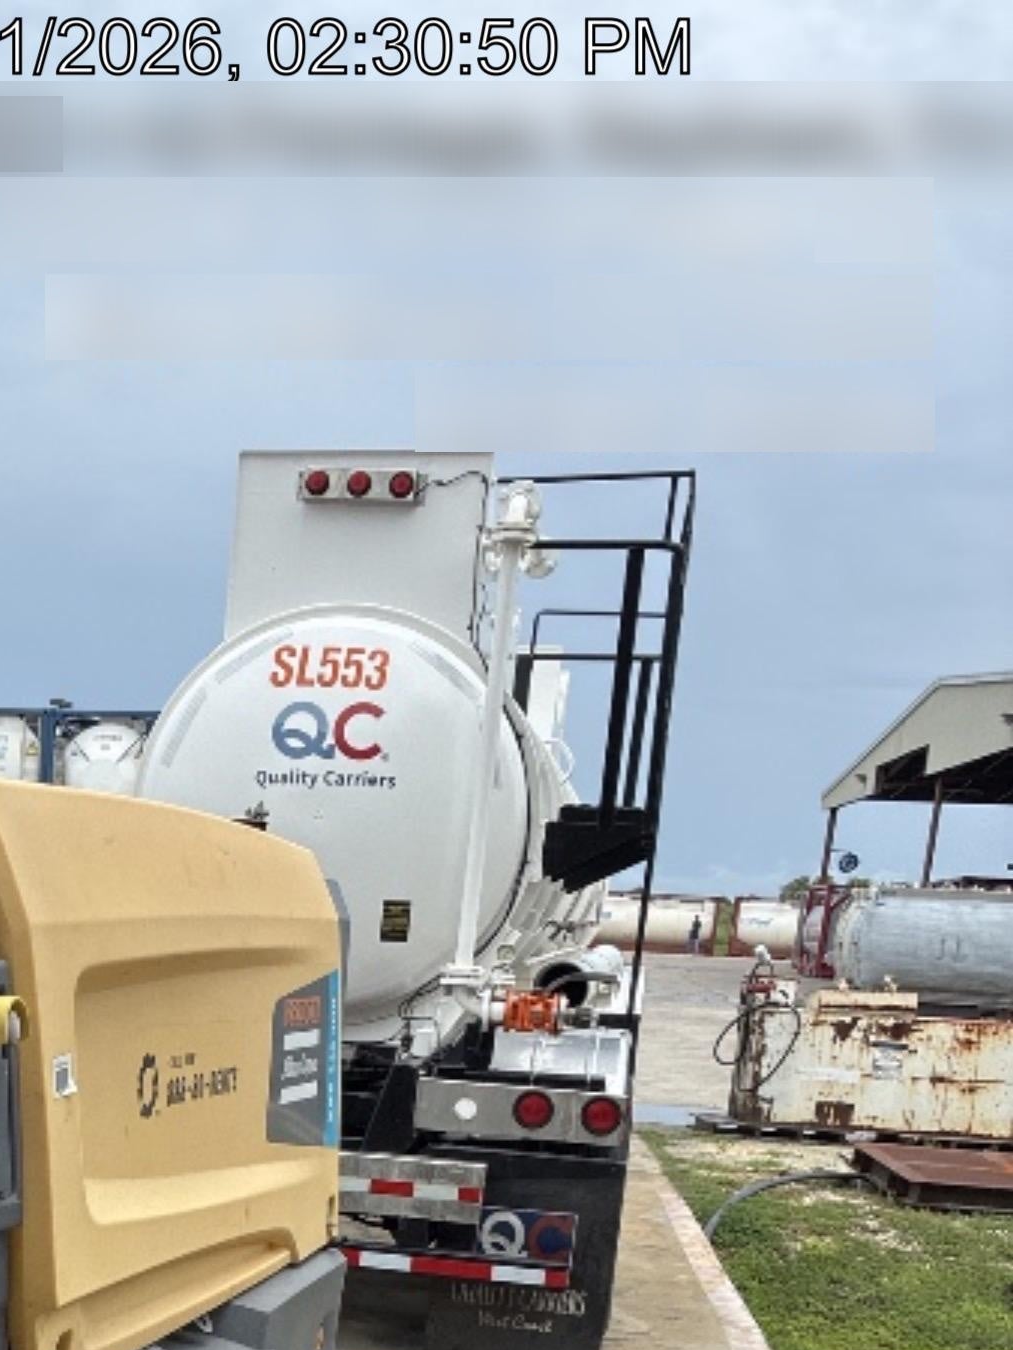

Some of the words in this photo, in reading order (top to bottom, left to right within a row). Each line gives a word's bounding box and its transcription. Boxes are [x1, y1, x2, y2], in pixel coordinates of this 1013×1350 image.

[269, 645, 390, 690] SL553
[272, 701, 386, 761] QC
[255, 768, 318, 789] Quality
[323, 770, 396, 789] Carriers
[481, 1211, 575, 1260] QC
